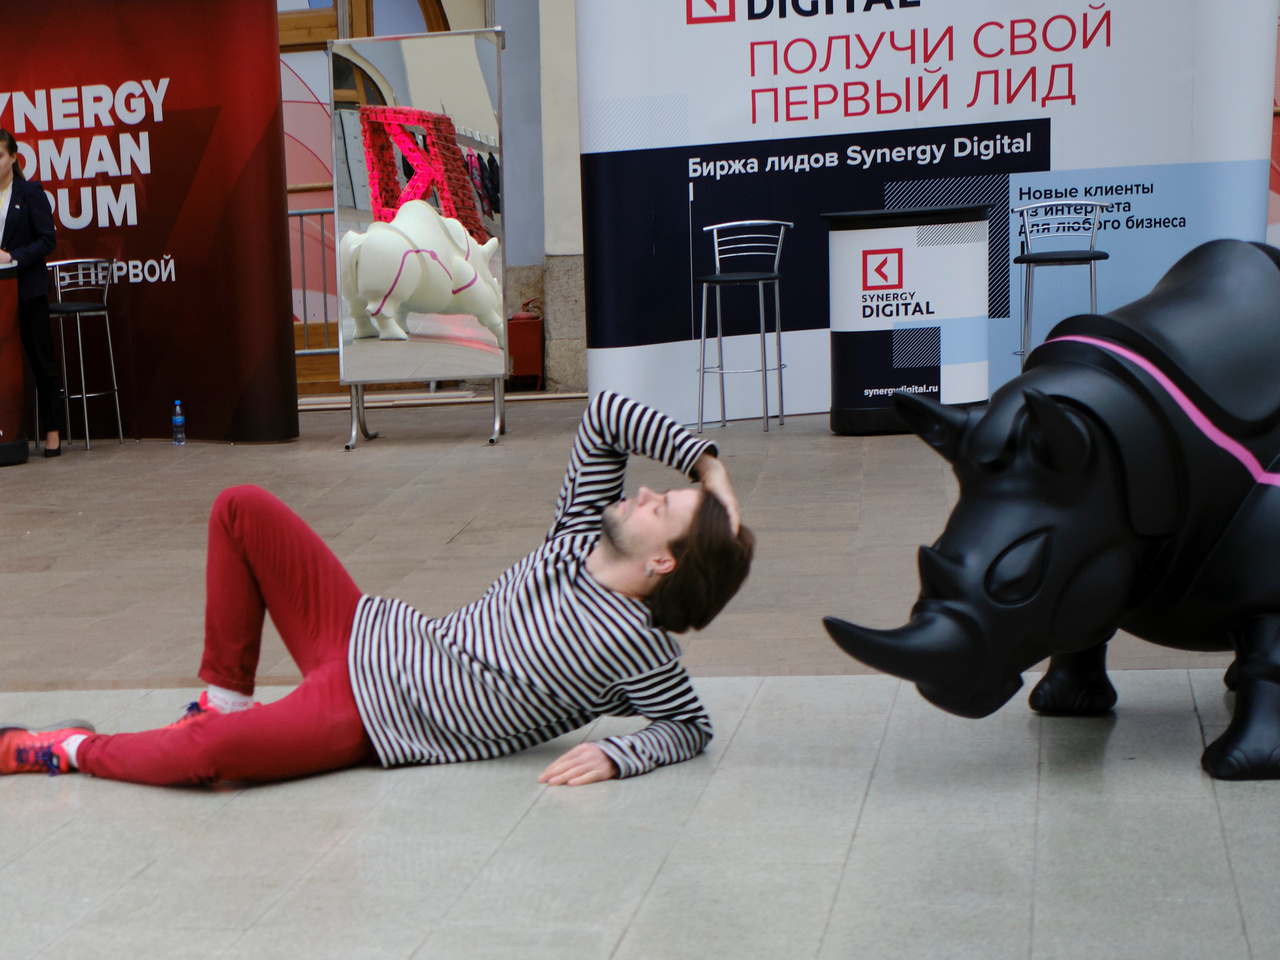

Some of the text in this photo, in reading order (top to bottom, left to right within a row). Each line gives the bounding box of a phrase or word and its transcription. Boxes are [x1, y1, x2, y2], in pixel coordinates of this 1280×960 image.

[750, 2, 1111, 77] ПОЛУЧИ СВОЙ
[751, 63, 1076, 124] ПЕРВЫЙ ЛИД
[688, 132, 1032, 180] Биржа лидов Synergy Digital
[1019, 183, 1154, 201] Новые клиенты
[1044, 201, 1131, 218] интерета
[1125, 214, 1186, 230] бизнеса
[77, 254, 176, 286] ПЕРВОЙ
[862, 291, 916, 303] SYNERGY
[862, 301, 935, 318] DIGITAL
